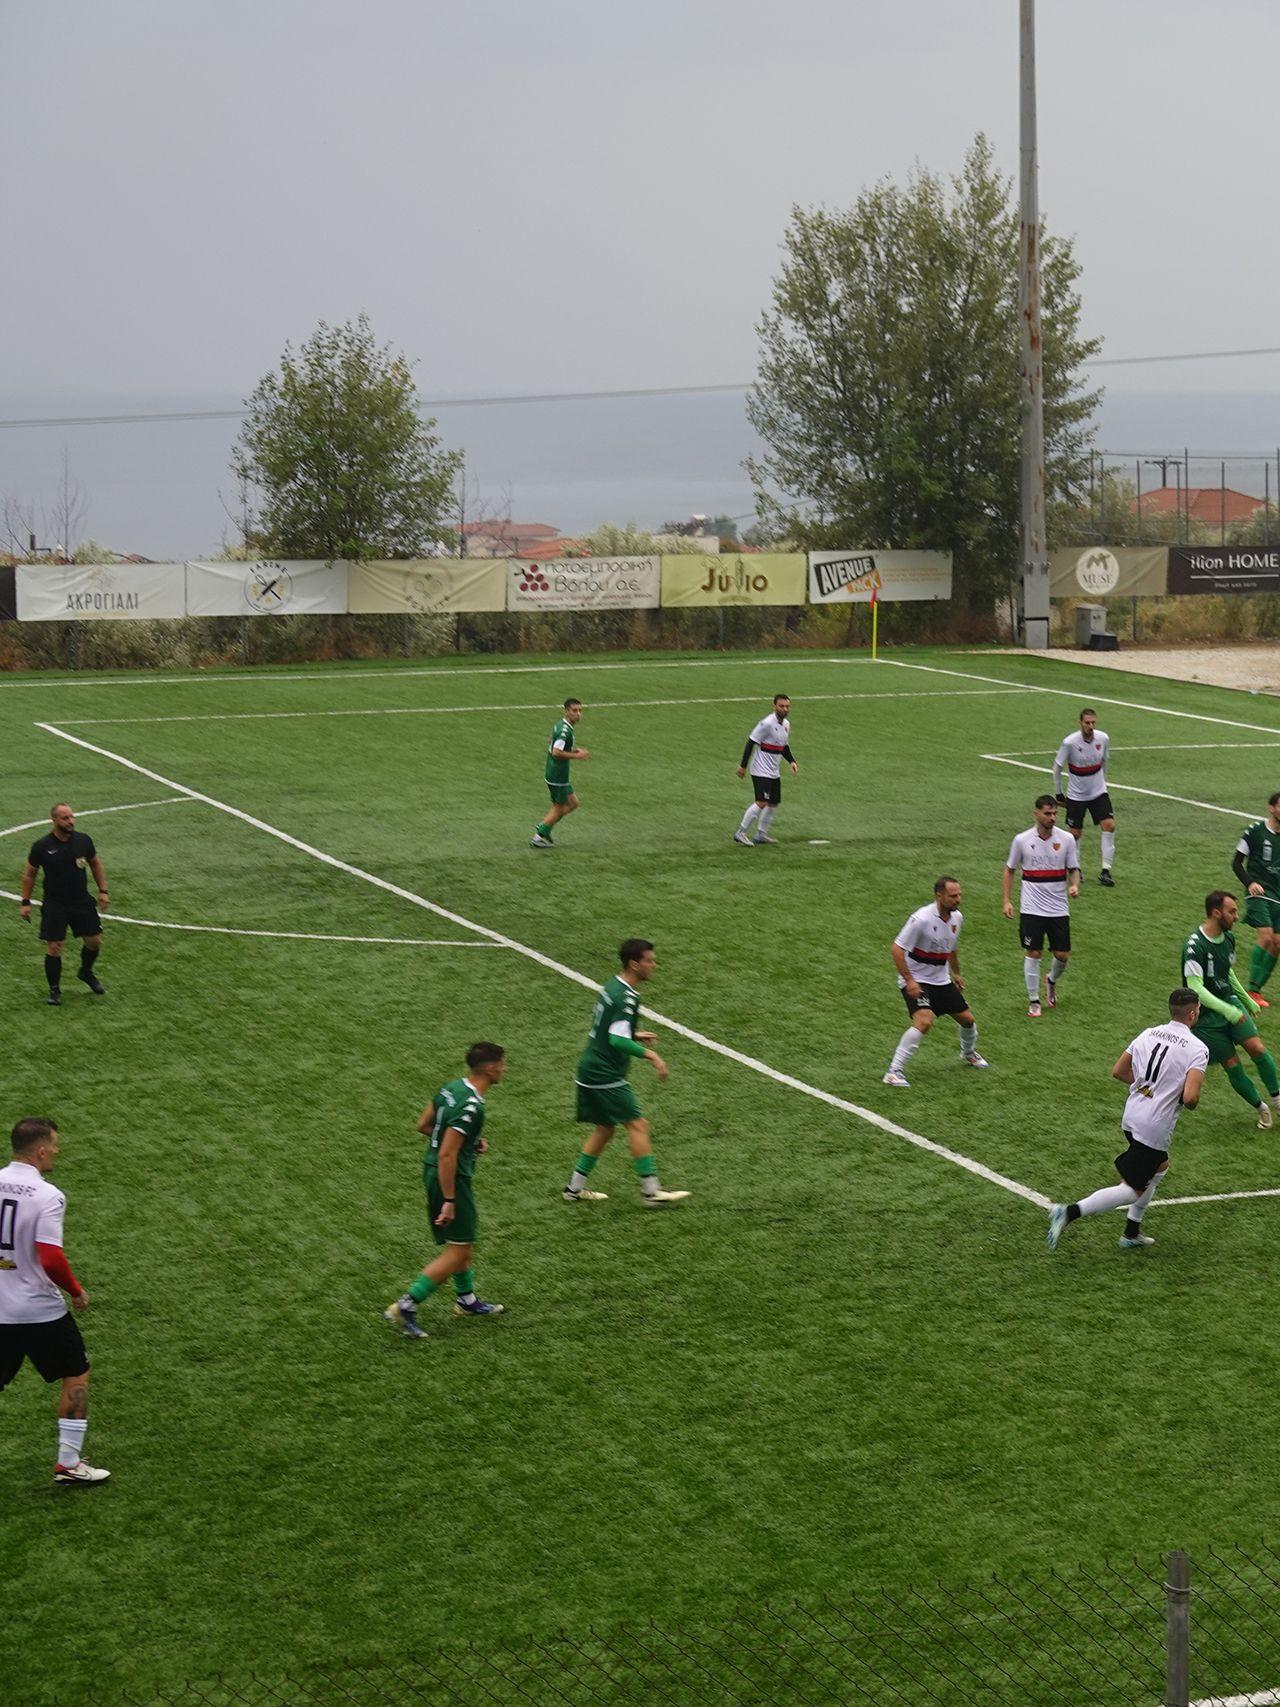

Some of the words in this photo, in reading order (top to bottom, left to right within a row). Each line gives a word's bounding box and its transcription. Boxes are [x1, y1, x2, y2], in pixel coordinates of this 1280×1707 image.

[1229, 553, 1280, 569] HOME
[819, 557, 875, 595] AVENUE
[1082, 573, 1114, 585] MUSE
[1177, 1037, 1189, 1048] FC
[1145, 1042, 1169, 1084] 11
